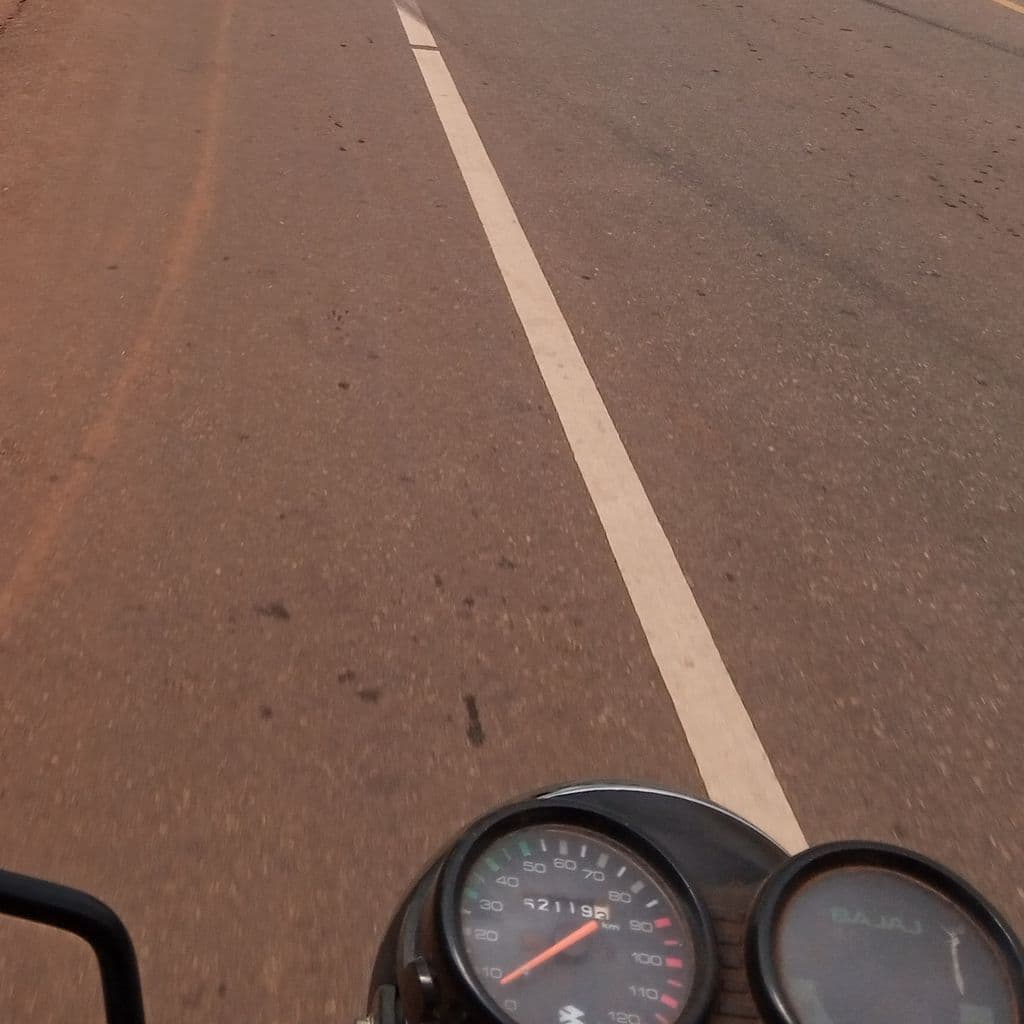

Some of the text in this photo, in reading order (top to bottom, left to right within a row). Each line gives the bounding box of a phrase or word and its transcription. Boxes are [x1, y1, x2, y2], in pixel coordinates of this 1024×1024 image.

[523, 861, 546, 874] 50
[554, 858, 576, 871] 60
[496, 875, 519, 888] 40
[582, 868, 605, 882] 70
[608, 890, 632, 904] 80
[479, 898, 503, 912] 30
[629, 920, 653, 933] 90
[474, 928, 498, 942] 20
[632, 952, 662, 966] 100
[482, 967, 502, 979] 10
[628, 985, 658, 1000] 110
[608, 1011, 640, 1024] 120
